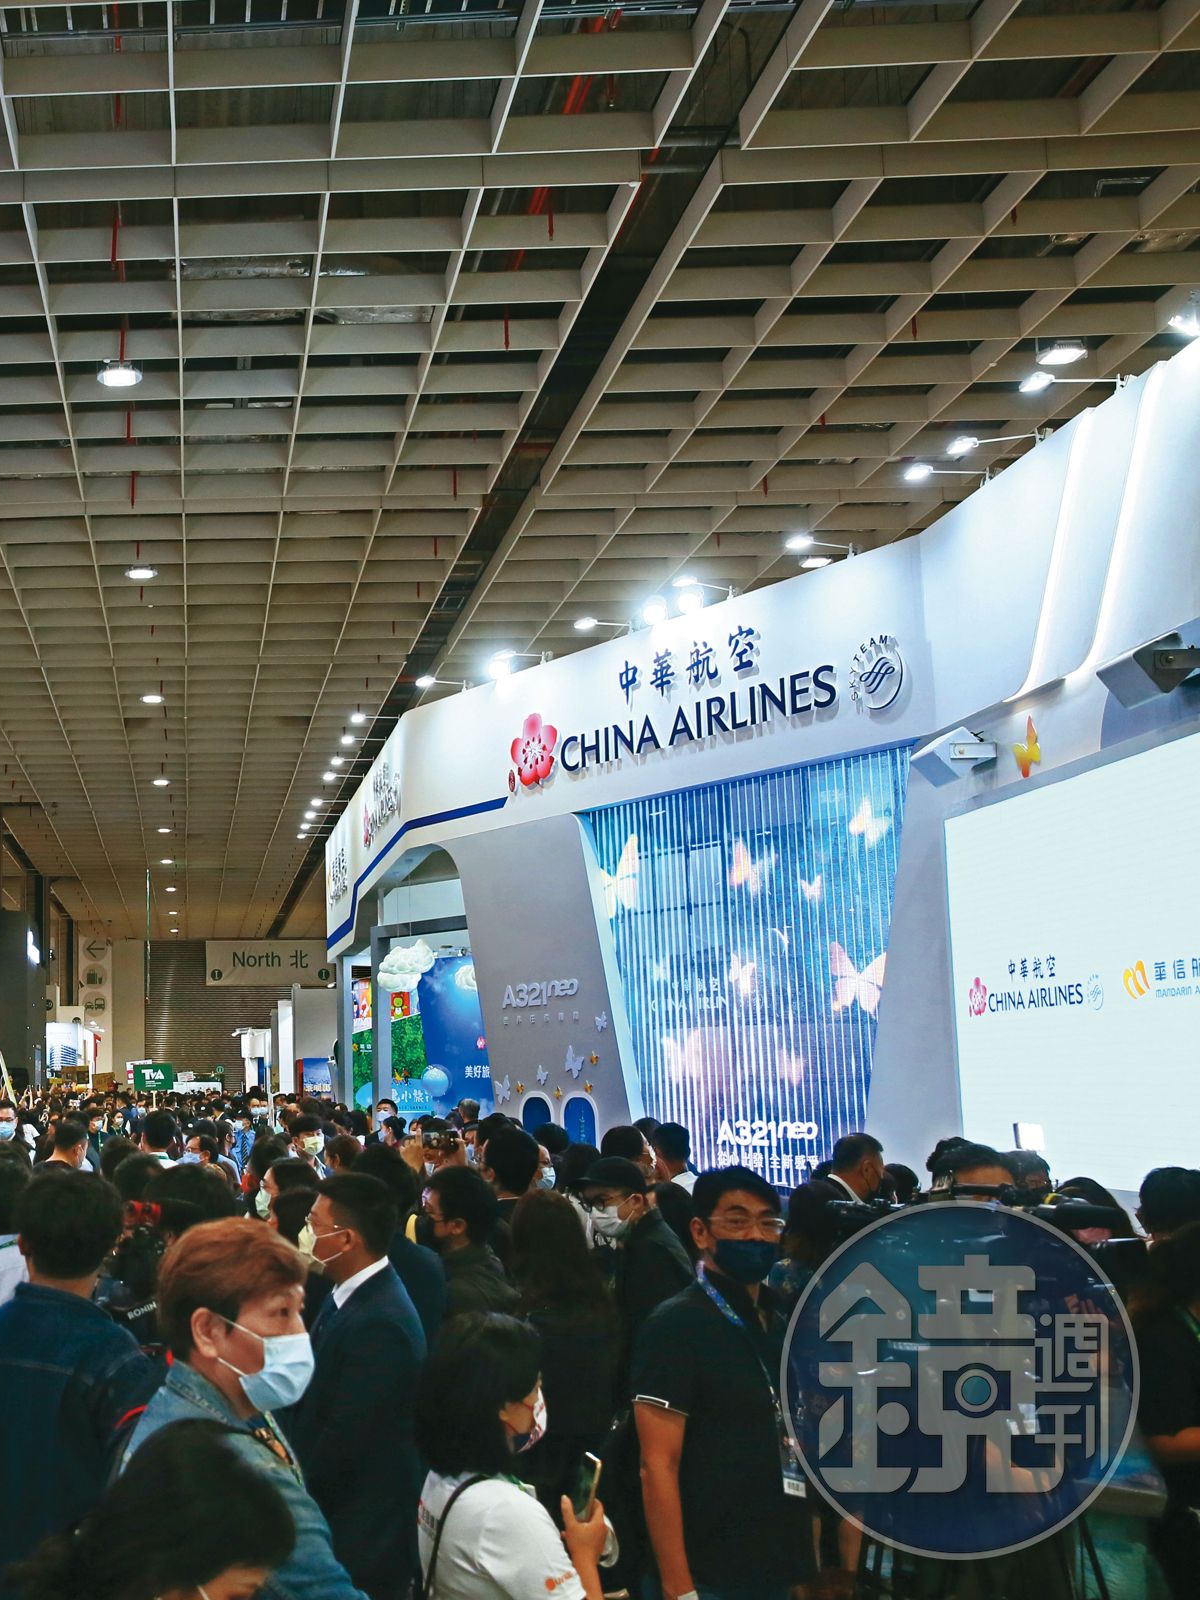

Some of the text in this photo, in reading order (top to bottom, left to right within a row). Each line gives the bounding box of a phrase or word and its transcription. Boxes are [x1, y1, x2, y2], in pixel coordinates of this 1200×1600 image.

[618, 625, 756, 705] 中華航空
[560, 665, 837, 772] CHINA AIRLINES
[232, 950, 308, 969] North 北
[1008, 954, 1056, 982] 中華航空
[502, 979, 579, 1009] A321neo
[988, 990, 1026, 1012] CHINA
[1028, 983, 1084, 1009] AIRLINES
[717, 1120, 818, 1147] A321neo
[127, 1301, 157, 1320] RONIN
